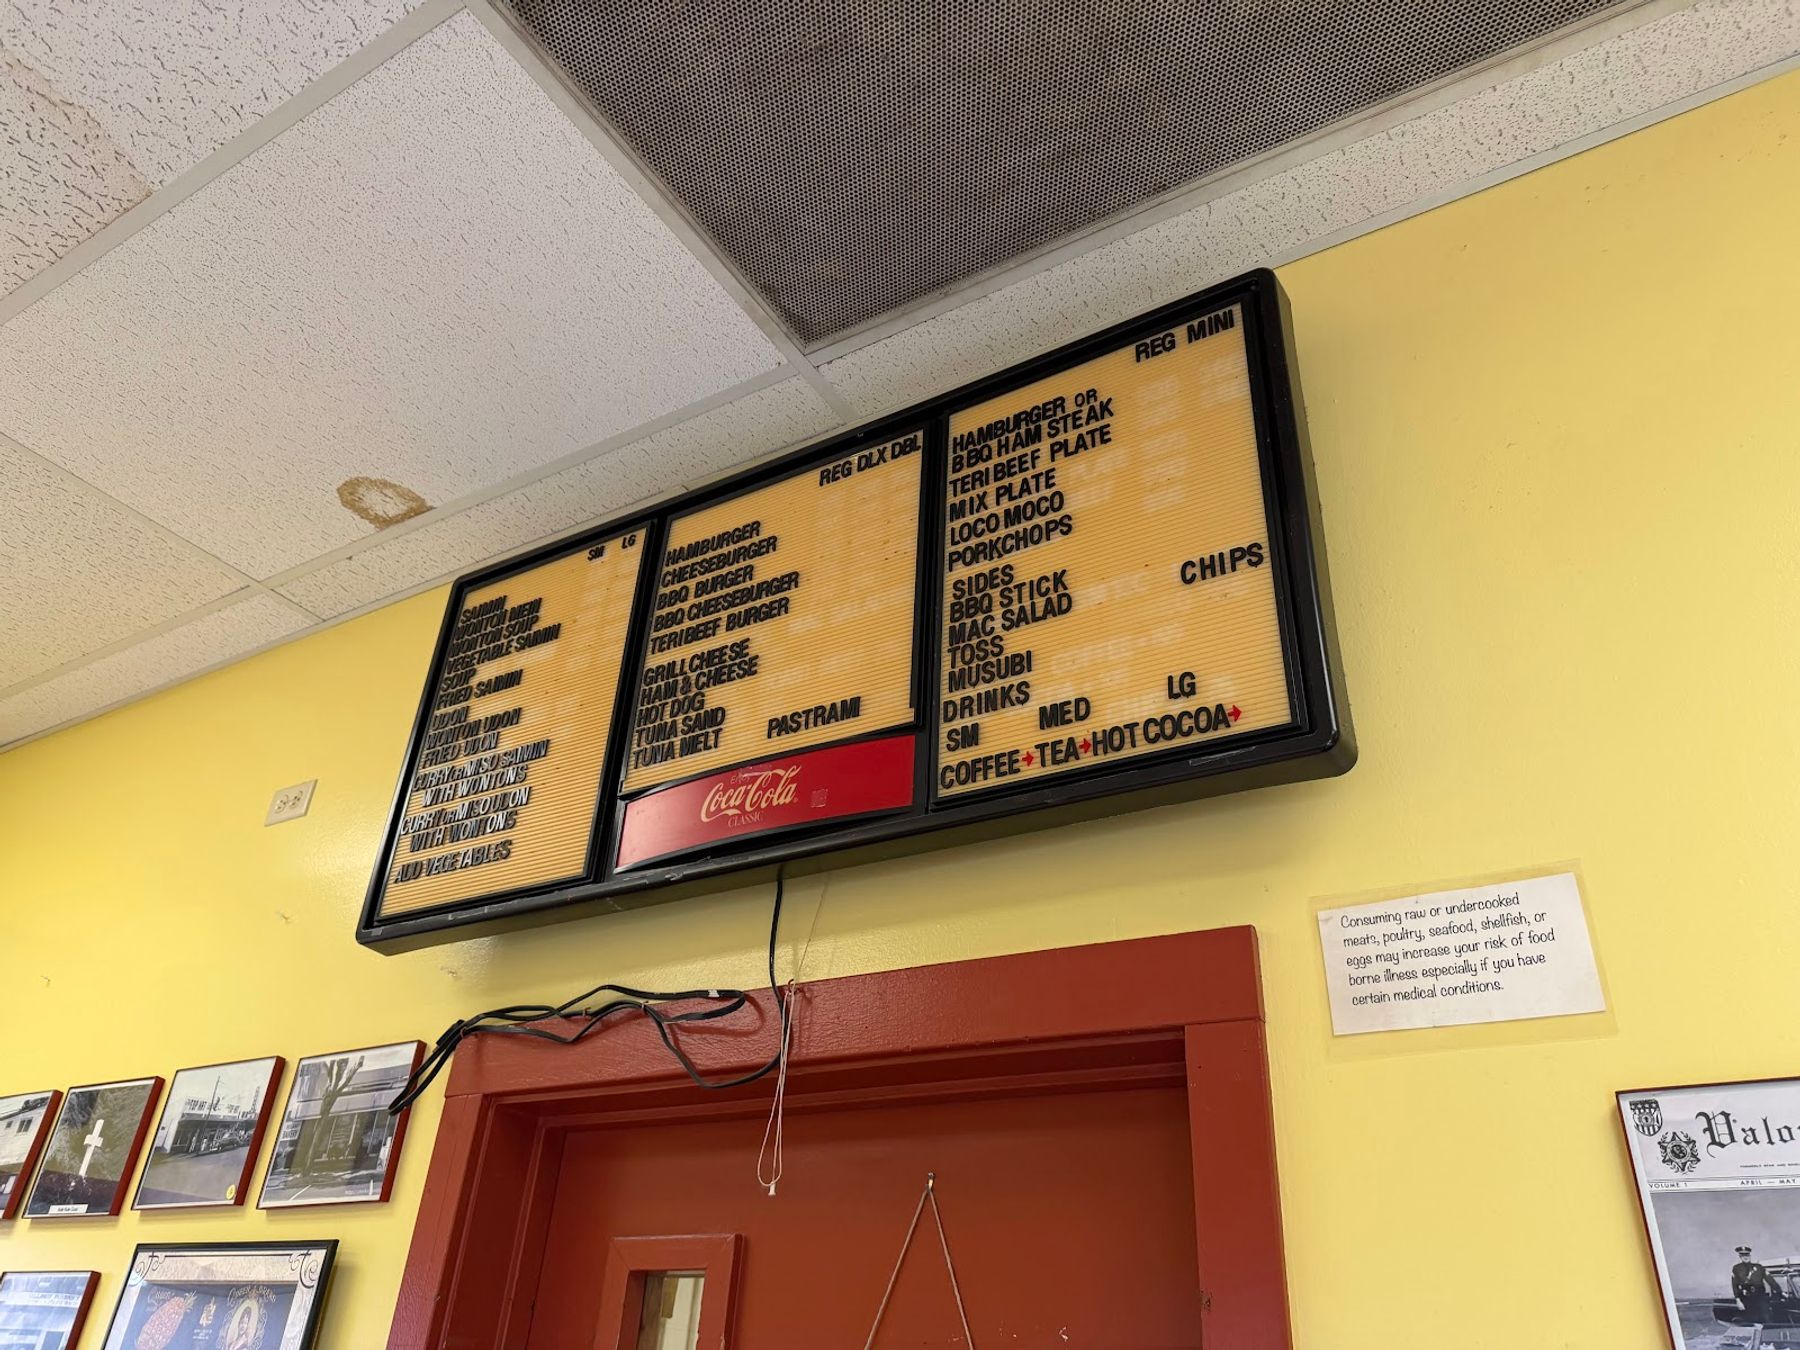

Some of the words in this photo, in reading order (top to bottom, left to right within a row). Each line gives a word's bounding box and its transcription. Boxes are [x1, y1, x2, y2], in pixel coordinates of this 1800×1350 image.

[1135, 332, 1176, 362] REG
[1186, 309, 1235, 344] MINI
[952, 396, 1066, 454] HAMBURGER
[1074, 388, 1098, 408] OR
[952, 444, 992, 474] BBQ
[997, 423, 1042, 457] HAM
[1047, 397, 1114, 438] STEAK
[819, 460, 853, 486] REG
[857, 446, 888, 472] DLX
[890, 434, 922, 460] DBL
[949, 468, 990, 497] TERI
[993, 449, 1041, 482] BEEF
[1050, 423, 1111, 462] PLATE
[950, 491, 988, 522] MIX
[996, 468, 1056, 506] PLATE
[950, 513, 1000, 546] LOCO
[1004, 490, 1064, 528] MOCO
[587, 546, 605, 561] SM
[621, 534, 636, 549] LG
[661, 535, 778, 588] CHEESEBURGER
[665, 520, 761, 567] HAMBURGER
[948, 514, 1073, 571] PORKCHOPS
[656, 585, 689, 611] BBQ
[693, 564, 754, 597] BURGER
[952, 564, 1014, 600] SIDES
[1180, 542, 1264, 584] CHIPS
[461, 595, 507, 624] SAIMIN
[653, 608, 685, 633] BBQ
[687, 570, 800, 622] CHEESEBURGER
[950, 592, 993, 623] BBQ
[999, 569, 1068, 609] STICK
[450, 626, 503, 658] WONTON
[503, 615, 540, 640] SOUP
[453, 609, 508, 641] WONTON
[650, 629, 684, 655] TERI
[683, 617, 721, 645] BEEF
[725, 597, 790, 632] BURGER
[948, 615, 995, 646] MAC
[1001, 592, 1072, 631] SALAD
[445, 639, 514, 675] VEGETABLE
[514, 623, 562, 652] SAIMIN
[643, 658, 687, 687] GRILL
[687, 637, 751, 673] CHEESE
[947, 635, 1004, 669] TOSS
[948, 650, 1033, 693] MUSUBI
[437, 685, 473, 709] FRIED
[474, 668, 523, 698] SAIMIN
[440, 668, 477, 692] SOUP
[640, 682, 677, 707] HAM
[679, 675, 692, 694] &
[694, 655, 760, 691] CHEESE
[943, 681, 1030, 723] DRINKS
[425, 719, 483, 750] WONTON
[483, 707, 522, 733] UDON
[431, 706, 470, 731] UDON
[635, 720, 678, 748] TUNA
[681, 707, 726, 736] SAND
[637, 703, 669, 728] HOT
[669, 692, 706, 716] DOG
[767, 696, 861, 739] PASTRAMI
[946, 723, 980, 752] SM
[1039, 697, 1091, 730] MED
[1167, 672, 1196, 700] LG
[412, 767, 451, 792] CURRY
[462, 754, 500, 779] MISO
[500, 739, 550, 767] SAIMIN
[421, 744, 460, 769] FRIED
[462, 731, 501, 757] UDON
[632, 742, 675, 770] TUNA
[678, 727, 724, 758] MELT
[940, 750, 1020, 789] COFFEE
[1035, 736, 1080, 768] TEA
[1092, 722, 1140, 757] HOT
[1143, 703, 1231, 745] COCOA
[422, 782, 456, 807] WITH
[457, 764, 528, 798] WONTONS
[700, 765, 802, 822] Coca-Cola
[401, 808, 443, 835] CURRY
[455, 796, 491, 820] MISO
[489, 786, 532, 813] UDON
[410, 827, 445, 852] WITH
[450, 810, 518, 844] WONTONS
[727, 810, 763, 828] CLASSIC
[394, 861, 423, 884] ADD
[424, 839, 513, 876] VEGETABLES
[1340, 912, 1402, 929] Consuming
[1404, 908, 1426, 922] raw
[1429, 906, 1442, 918] or
[1445, 892, 1520, 916] undercooked
[1343, 933, 1381, 949] meats,
[1382, 927, 1426, 947] poultry,
[1428, 919, 1478, 937] seafood,
[1480, 912, 1531, 931] shellfish,
[1533, 912, 1547, 924] or
[1346, 954, 1373, 969] eggs
[1375, 950, 1400, 965] may
[1402, 943, 1451, 961] increase
[1454, 940, 1481, 956] your
[1484, 933, 1508, 950] risk
[1510, 931, 1526, 947] of
[1528, 927, 1555, 944] food
[1348, 972, 1381, 987] borne
[1383, 967, 1418, 984] illness
[1421, 959, 1478, 980] especially
[1480, 957, 1490, 972] if
[1492, 957, 1515, 974] you
[1518, 952, 1546, 968] have
[1351, 990, 1391, 1006] certain
[1393, 984, 1437, 1002] medical
[1440, 979, 1505, 998] conditions.
[1695, 1110, 1800, 1159] Valo
[1648, 1181, 1680, 1189] VOLUME
